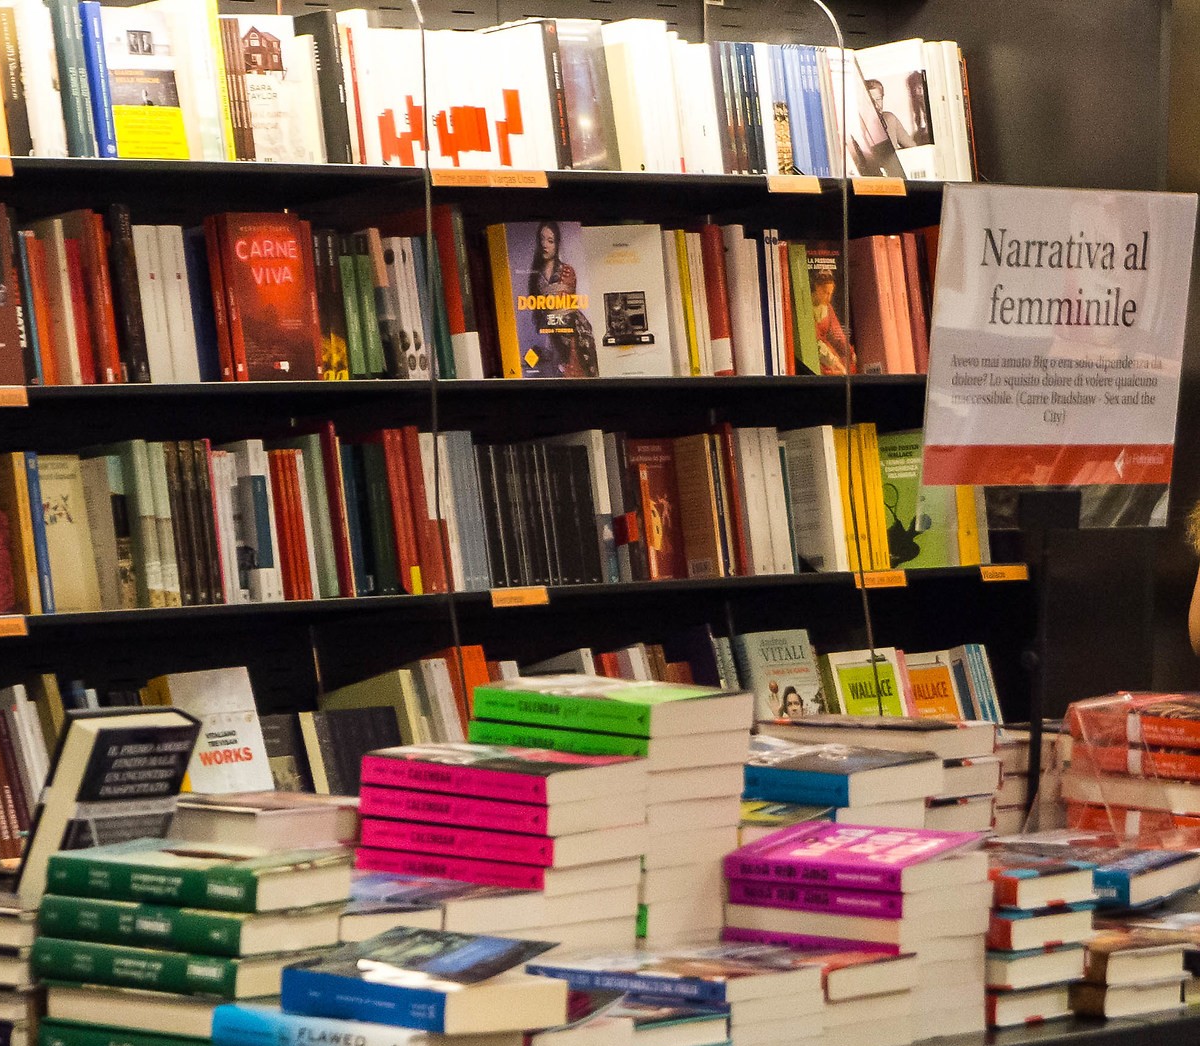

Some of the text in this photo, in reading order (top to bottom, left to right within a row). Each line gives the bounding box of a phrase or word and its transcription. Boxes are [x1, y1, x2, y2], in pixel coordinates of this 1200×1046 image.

[247, 92, 278, 100] TAYLOR
[235, 239, 297, 261] CARNE
[980, 228, 1149, 271] Narrativa al
[251, 266, 293, 285] VIVA
[517, 294, 589, 311] DOROMIZU
[988, 284, 1137, 327] femminile
[951, 355, 979, 369] Avevo
[981, 355, 999, 369] mai
[1001, 356, 1031, 369] amato
[1033, 355, 1048, 372] Big
[951, 373, 1158, 390] dolore? Lo squisito dolore di volere qualcuno
[1051, 391, 1096, 405] Bradshaw
[1104, 391, 1120, 405] Sex
[1122, 391, 1139, 405] and
[1140, 391, 1156, 405] the
[759, 645, 806, 662] VITALI
[519, 700, 560, 715] CALENDAR
[199, 746, 253, 767] WORKS
[408, 768, 452, 784] CALENDAR
[406, 799, 451, 814] CALENDAR
[410, 830, 455, 845] CALENDAR
[402, 859, 447, 875] CALENDAR
